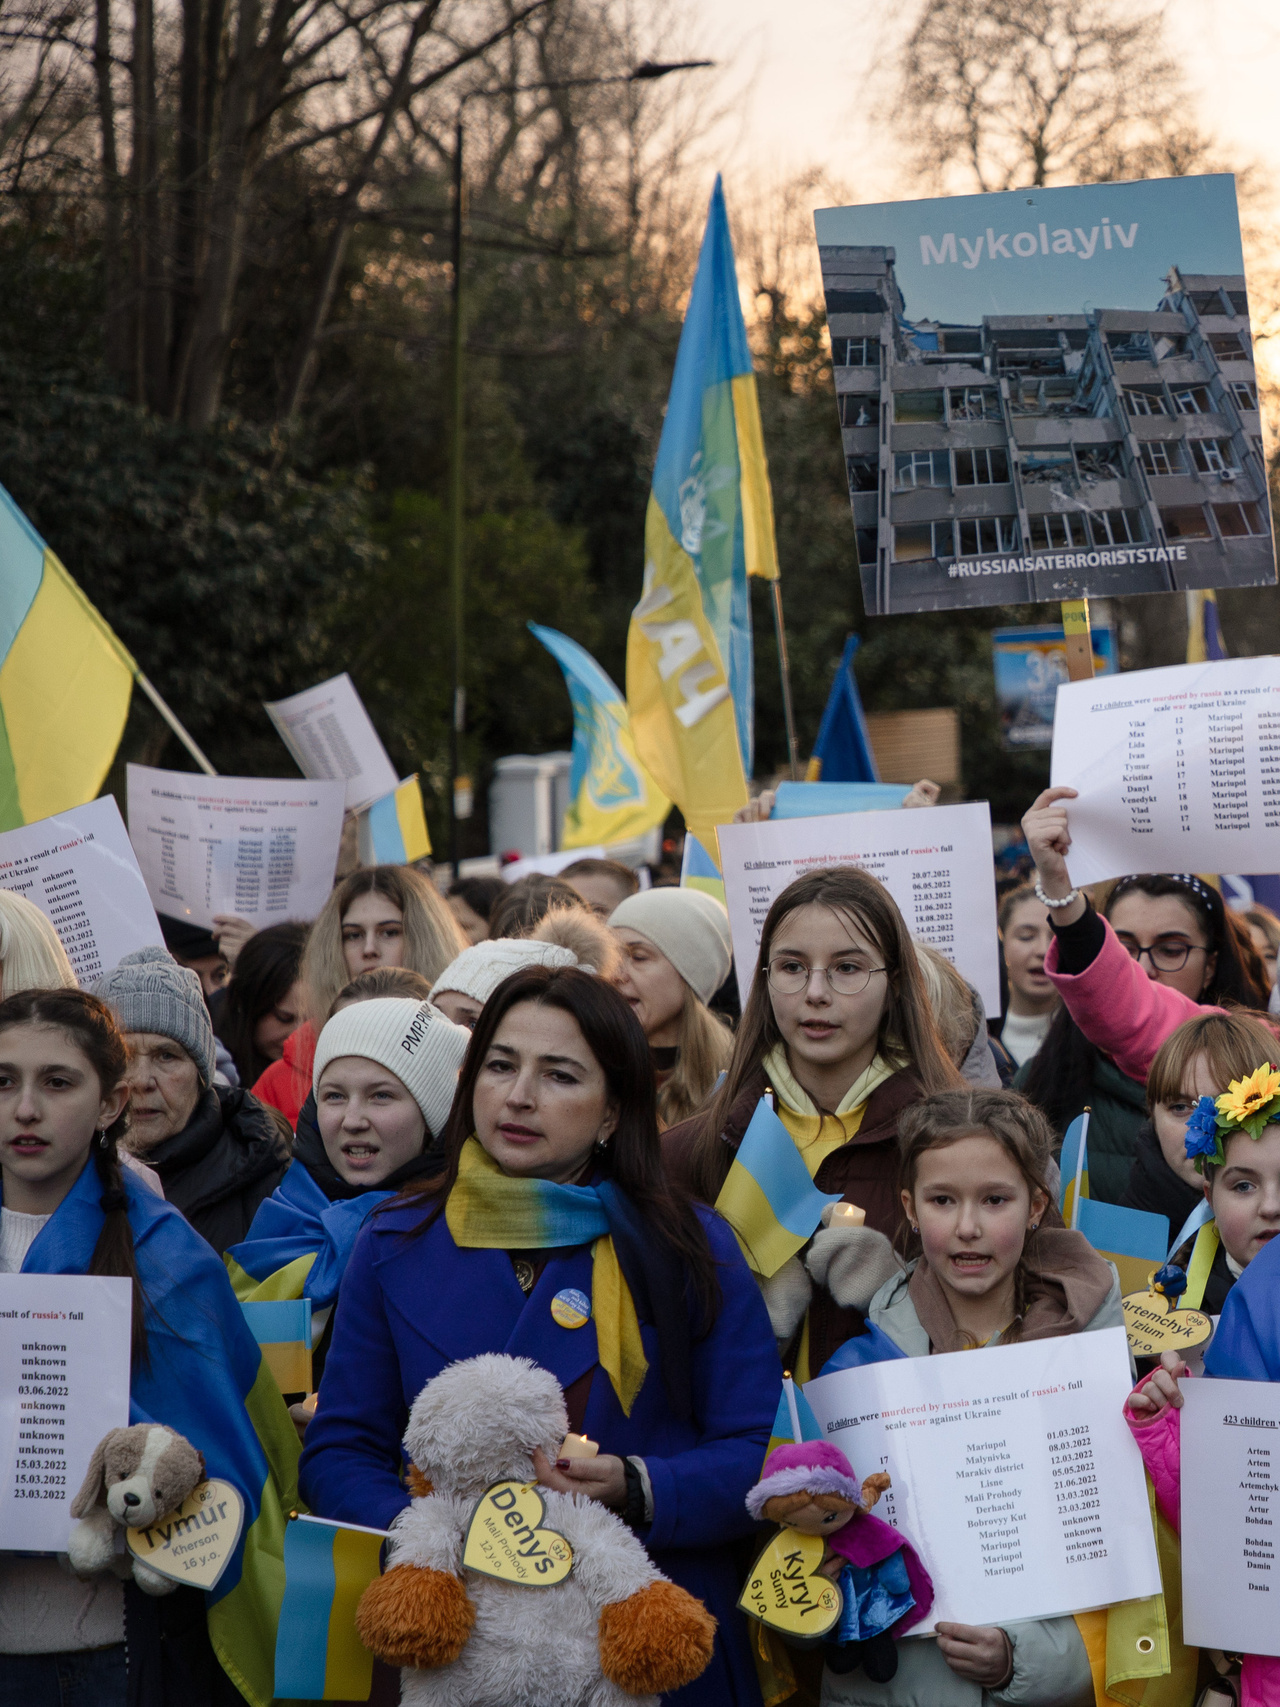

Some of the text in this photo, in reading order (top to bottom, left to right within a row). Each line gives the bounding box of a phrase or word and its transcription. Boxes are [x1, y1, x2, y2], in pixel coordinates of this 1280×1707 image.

[919, 217, 1138, 269] Mykolayiv
[948, 546, 1187, 578] #RUSSIAISATERRORISTSTATE
[30, 833, 94, 861] result russia's full
[911, 847, 938, 855] russia's
[9, 866, 39, 878] Ukraine
[42, 868, 74, 883] unknown
[912, 870, 950, 879] 20.07.2022
[45, 879, 76, 893] unknown
[912, 881, 950, 890] 06.05.2022
[50, 900, 82, 914] unknown
[32, 1311, 83, 1320] russia's full
[1122, 1301, 1194, 1337] Artemchyk
[1131, 1320, 1164, 1339] Izium
[22, 1342, 66, 1351] unknown
[1132, 1339, 1153, 1352] y.o.
[22, 1357, 66, 1366] unknown
[18, 1386, 68, 1396] 03.06.2022
[881, 1384, 1065, 1418] murdered russia result russia's
[20, 1416, 65, 1425] unknown
[930, 1408, 1001, 1426] against Ukraine
[1222, 1415, 1238, 1426] 423
[1239, 1416, 1276, 1428] children
[1047, 1425, 1089, 1440] 01.03.2022
[966, 1452, 1010, 1465] Malynivka
[1247, 1448, 1270, 1456] Artem
[16, 1460, 66, 1470] 15.03.2022
[994, 1462, 1024, 1474] district
[1051, 1450, 1093, 1464] 12.03.2022
[1239, 1481, 1279, 1492] Artemchyk
[14, 1489, 65, 1499] 23.03.2022
[199, 1490, 212, 1502] 82
[976, 1487, 1098, 1514] Derhachi 13.03.2022
[987, 1488, 1022, 1500] Prohody
[1249, 1494, 1269, 1502] Artur
[138, 1498, 228, 1550] Tymur
[967, 1517, 1007, 1528] Bobrovyy
[1245, 1516, 1272, 1525] Bohdan
[490, 1488, 554, 1574] Denys
[171, 1531, 219, 1557] Kherson
[483, 1517, 528, 1578] Mali Prohody
[182, 1550, 220, 1571] 16 y.o.
[480, 1541, 501, 1571] 12 y.o.
[1243, 1549, 1274, 1559] Bohdana
[1247, 1561, 1270, 1570] Damin
[770, 1570, 788, 1608] Sumy
[783, 1551, 819, 1616] Kyryl
[1249, 1583, 1270, 1592] Dania
[751, 1580, 767, 1618] 6 y.o.
[822, 1594, 833, 1608] 257
